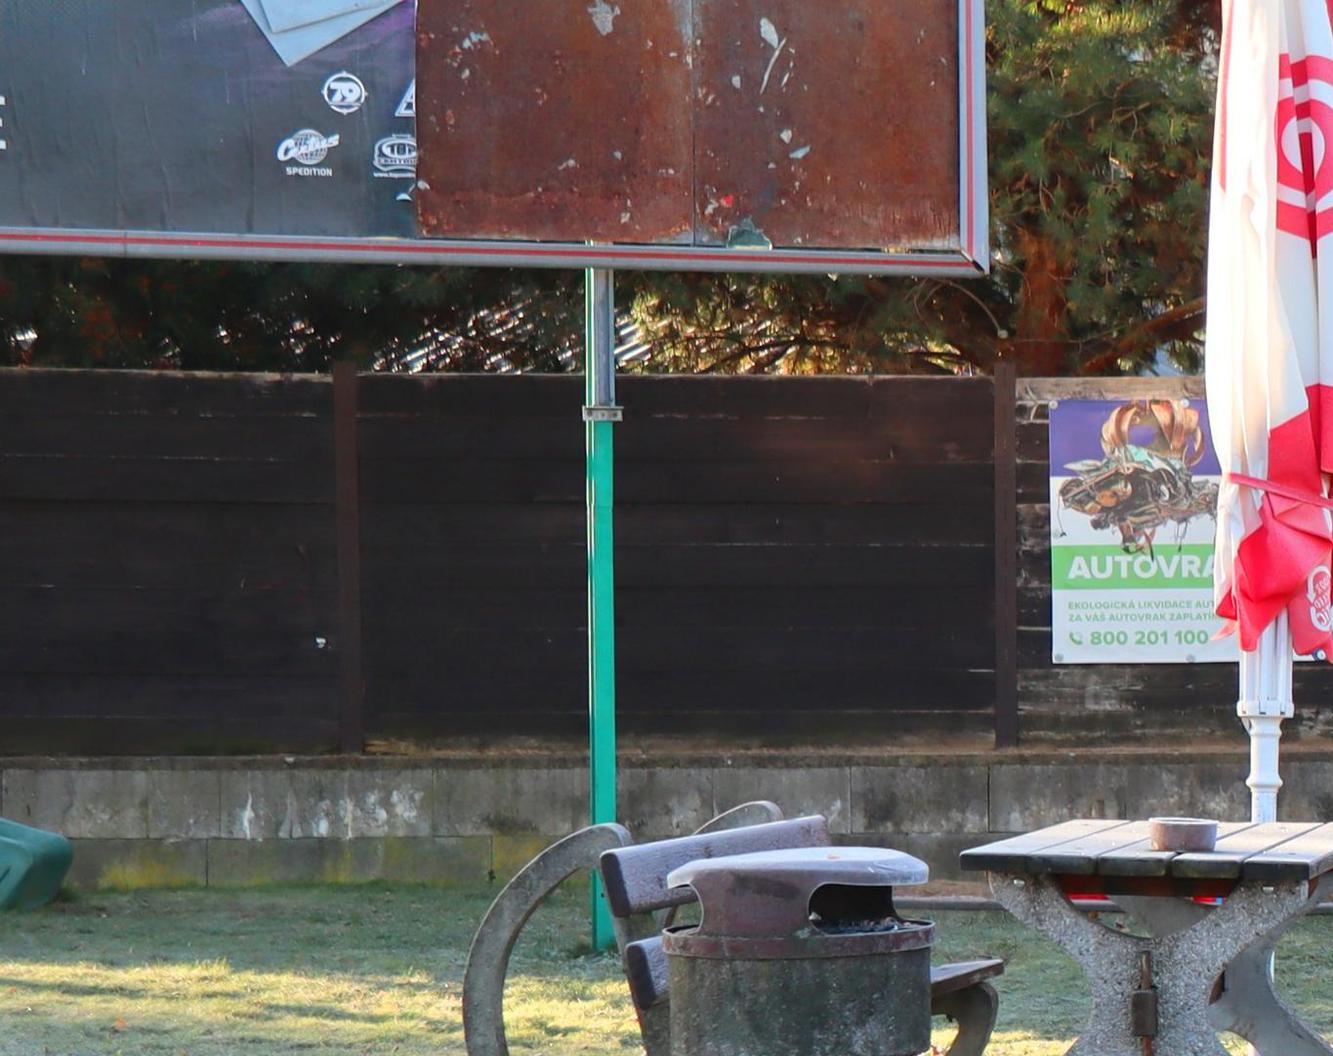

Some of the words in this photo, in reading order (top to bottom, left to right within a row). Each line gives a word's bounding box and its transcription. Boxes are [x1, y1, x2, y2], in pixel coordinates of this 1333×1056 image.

[329, 81, 361, 103] 79
[286, 167, 333, 177] SPEDITION
[1068, 599, 1135, 610] EKOLOGICKÁ
[1138, 600, 1193, 609] LIKVIDACE
[1068, 613, 1082, 622] ZA
[1109, 613, 1167, 622] AUTOVRAK
[1090, 631, 1128, 645] 800
[1135, 631, 1168, 645] 201
[1174, 630, 1209, 645] 100
